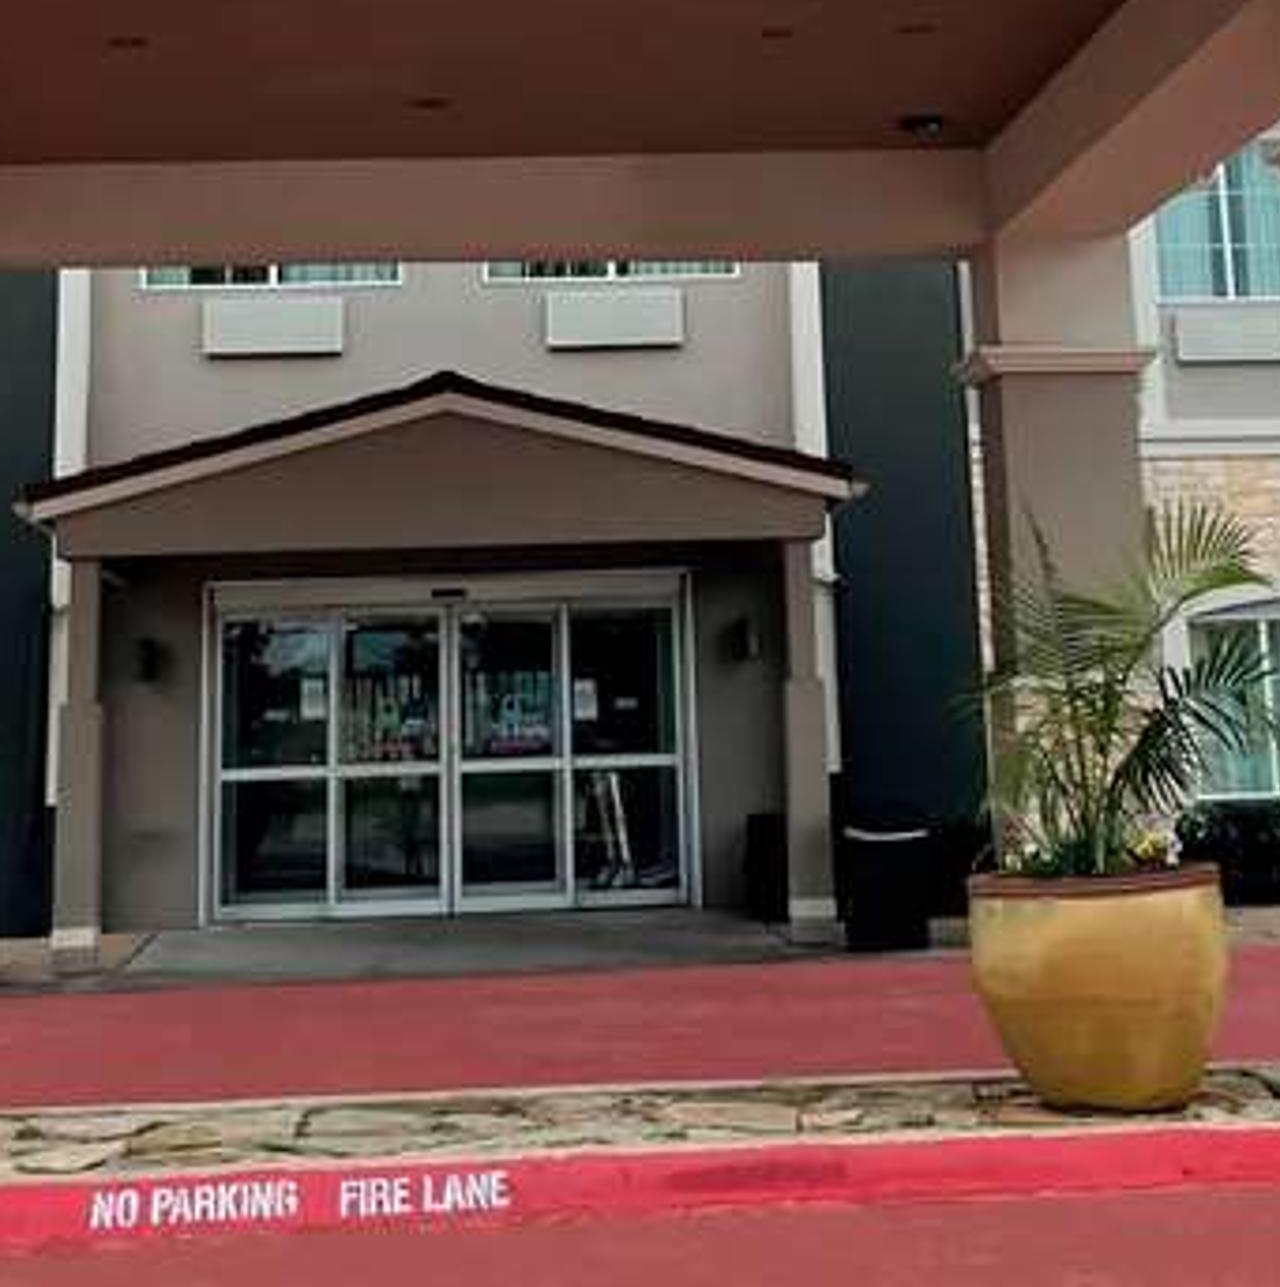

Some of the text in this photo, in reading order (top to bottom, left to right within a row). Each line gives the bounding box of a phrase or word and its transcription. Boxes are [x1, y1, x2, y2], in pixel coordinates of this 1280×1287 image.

[89, 1170, 512, 1229] NO PARKING FIRE LANE
